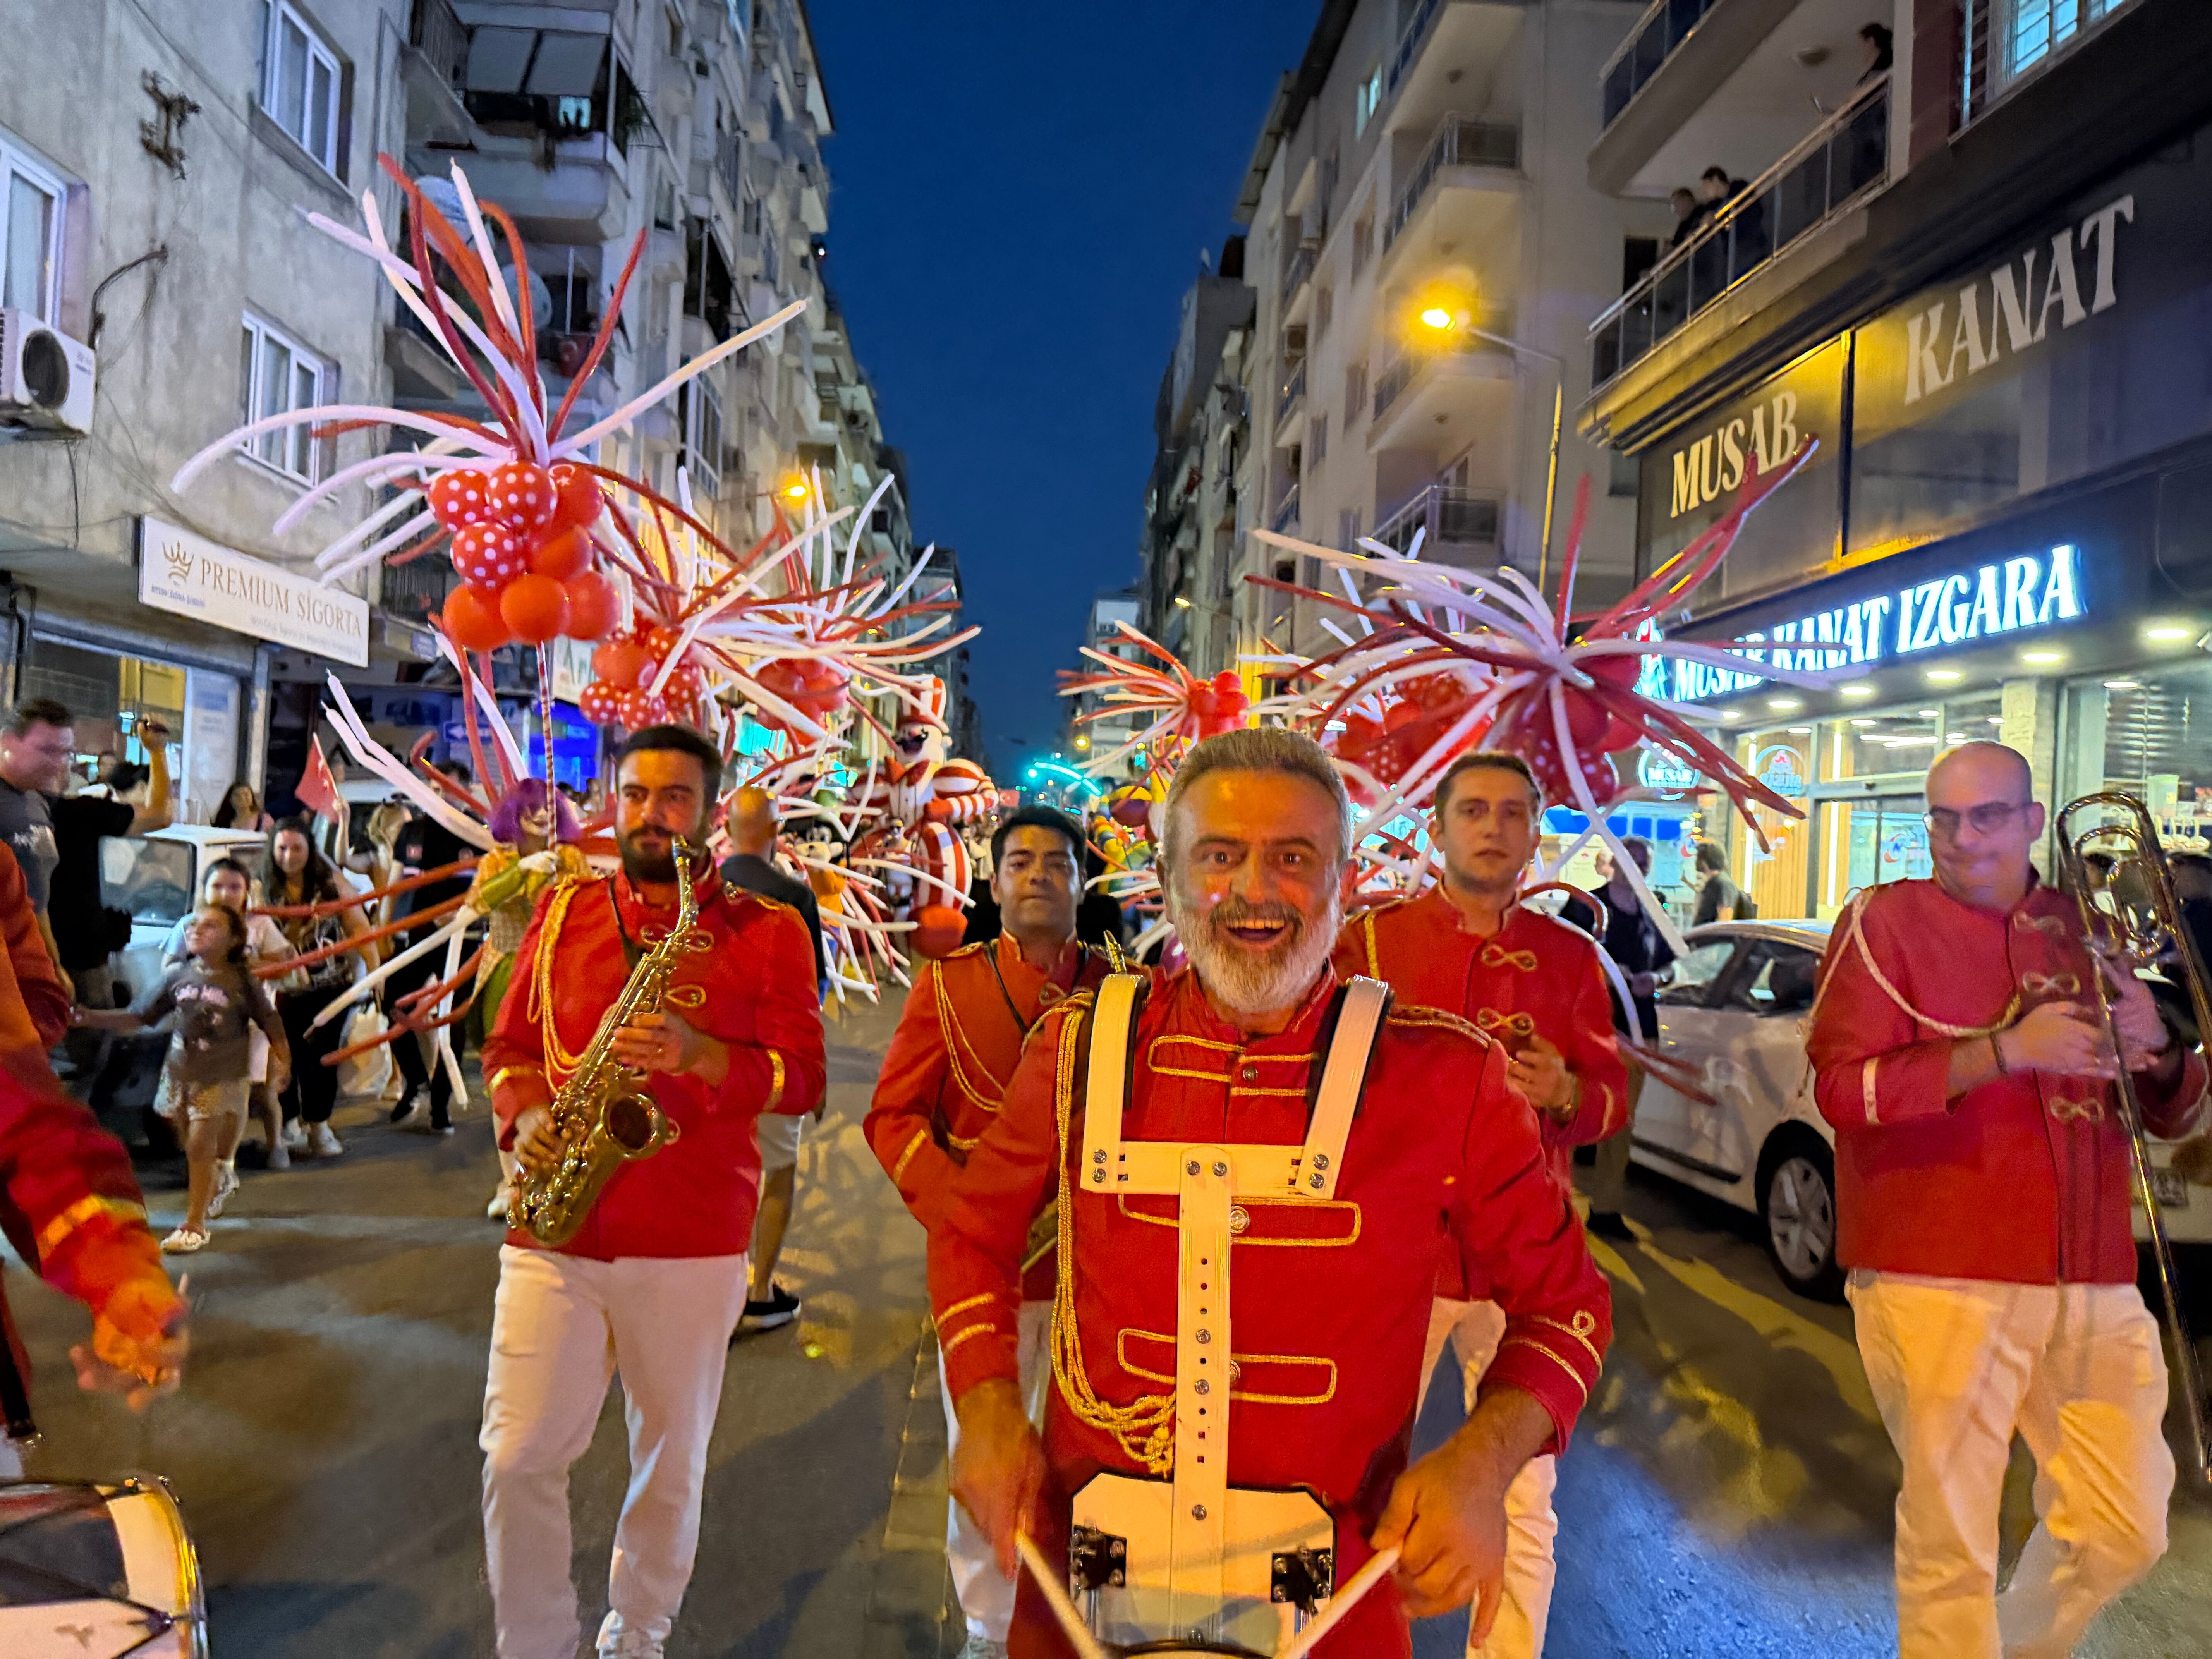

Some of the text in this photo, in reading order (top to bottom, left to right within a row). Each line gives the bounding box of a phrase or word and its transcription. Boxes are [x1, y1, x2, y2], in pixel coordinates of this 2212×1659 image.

[1905, 193, 2133, 405] KANAT
[1671, 391, 1797, 518] MUSAB
[201, 558, 289, 614] PREMIUM
[1772, 596, 1889, 671] KANAT
[1896, 544, 2080, 654] IZGARA
